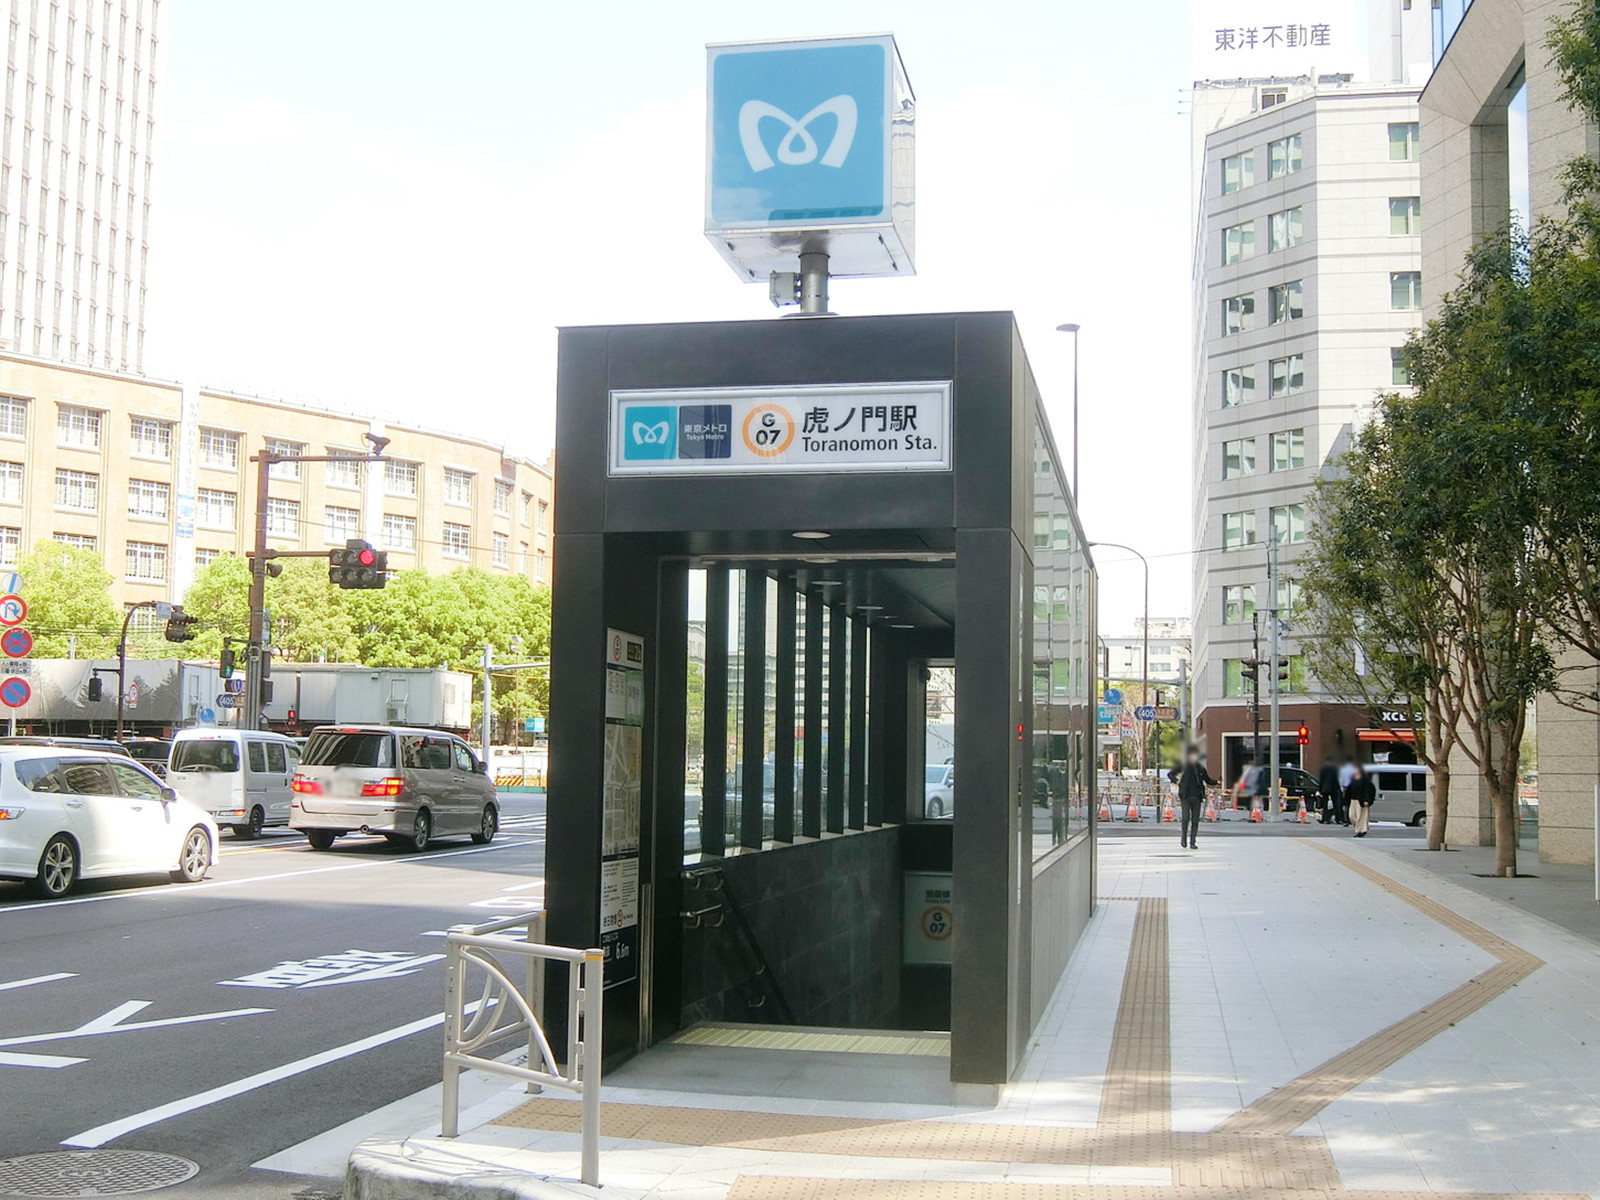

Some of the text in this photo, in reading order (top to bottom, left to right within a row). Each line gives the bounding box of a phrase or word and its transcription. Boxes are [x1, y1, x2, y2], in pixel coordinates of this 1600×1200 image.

[1214, 23, 1331, 51] 東洋不動産
[761, 412, 776, 428] G
[802, 406, 918, 434] 虎ノ門駅
[684, 423, 728, 434] 東京メトロ
[686, 433, 725, 442] Tokyo Metro
[755, 429, 782, 446] 07
[802, 434, 938, 452] Toranomon Sta.
[221, 697, 234, 706] 405
[1140, 708, 1155, 719] 405
[933, 911, 943, 922] G
[929, 922, 946, 934] 07
